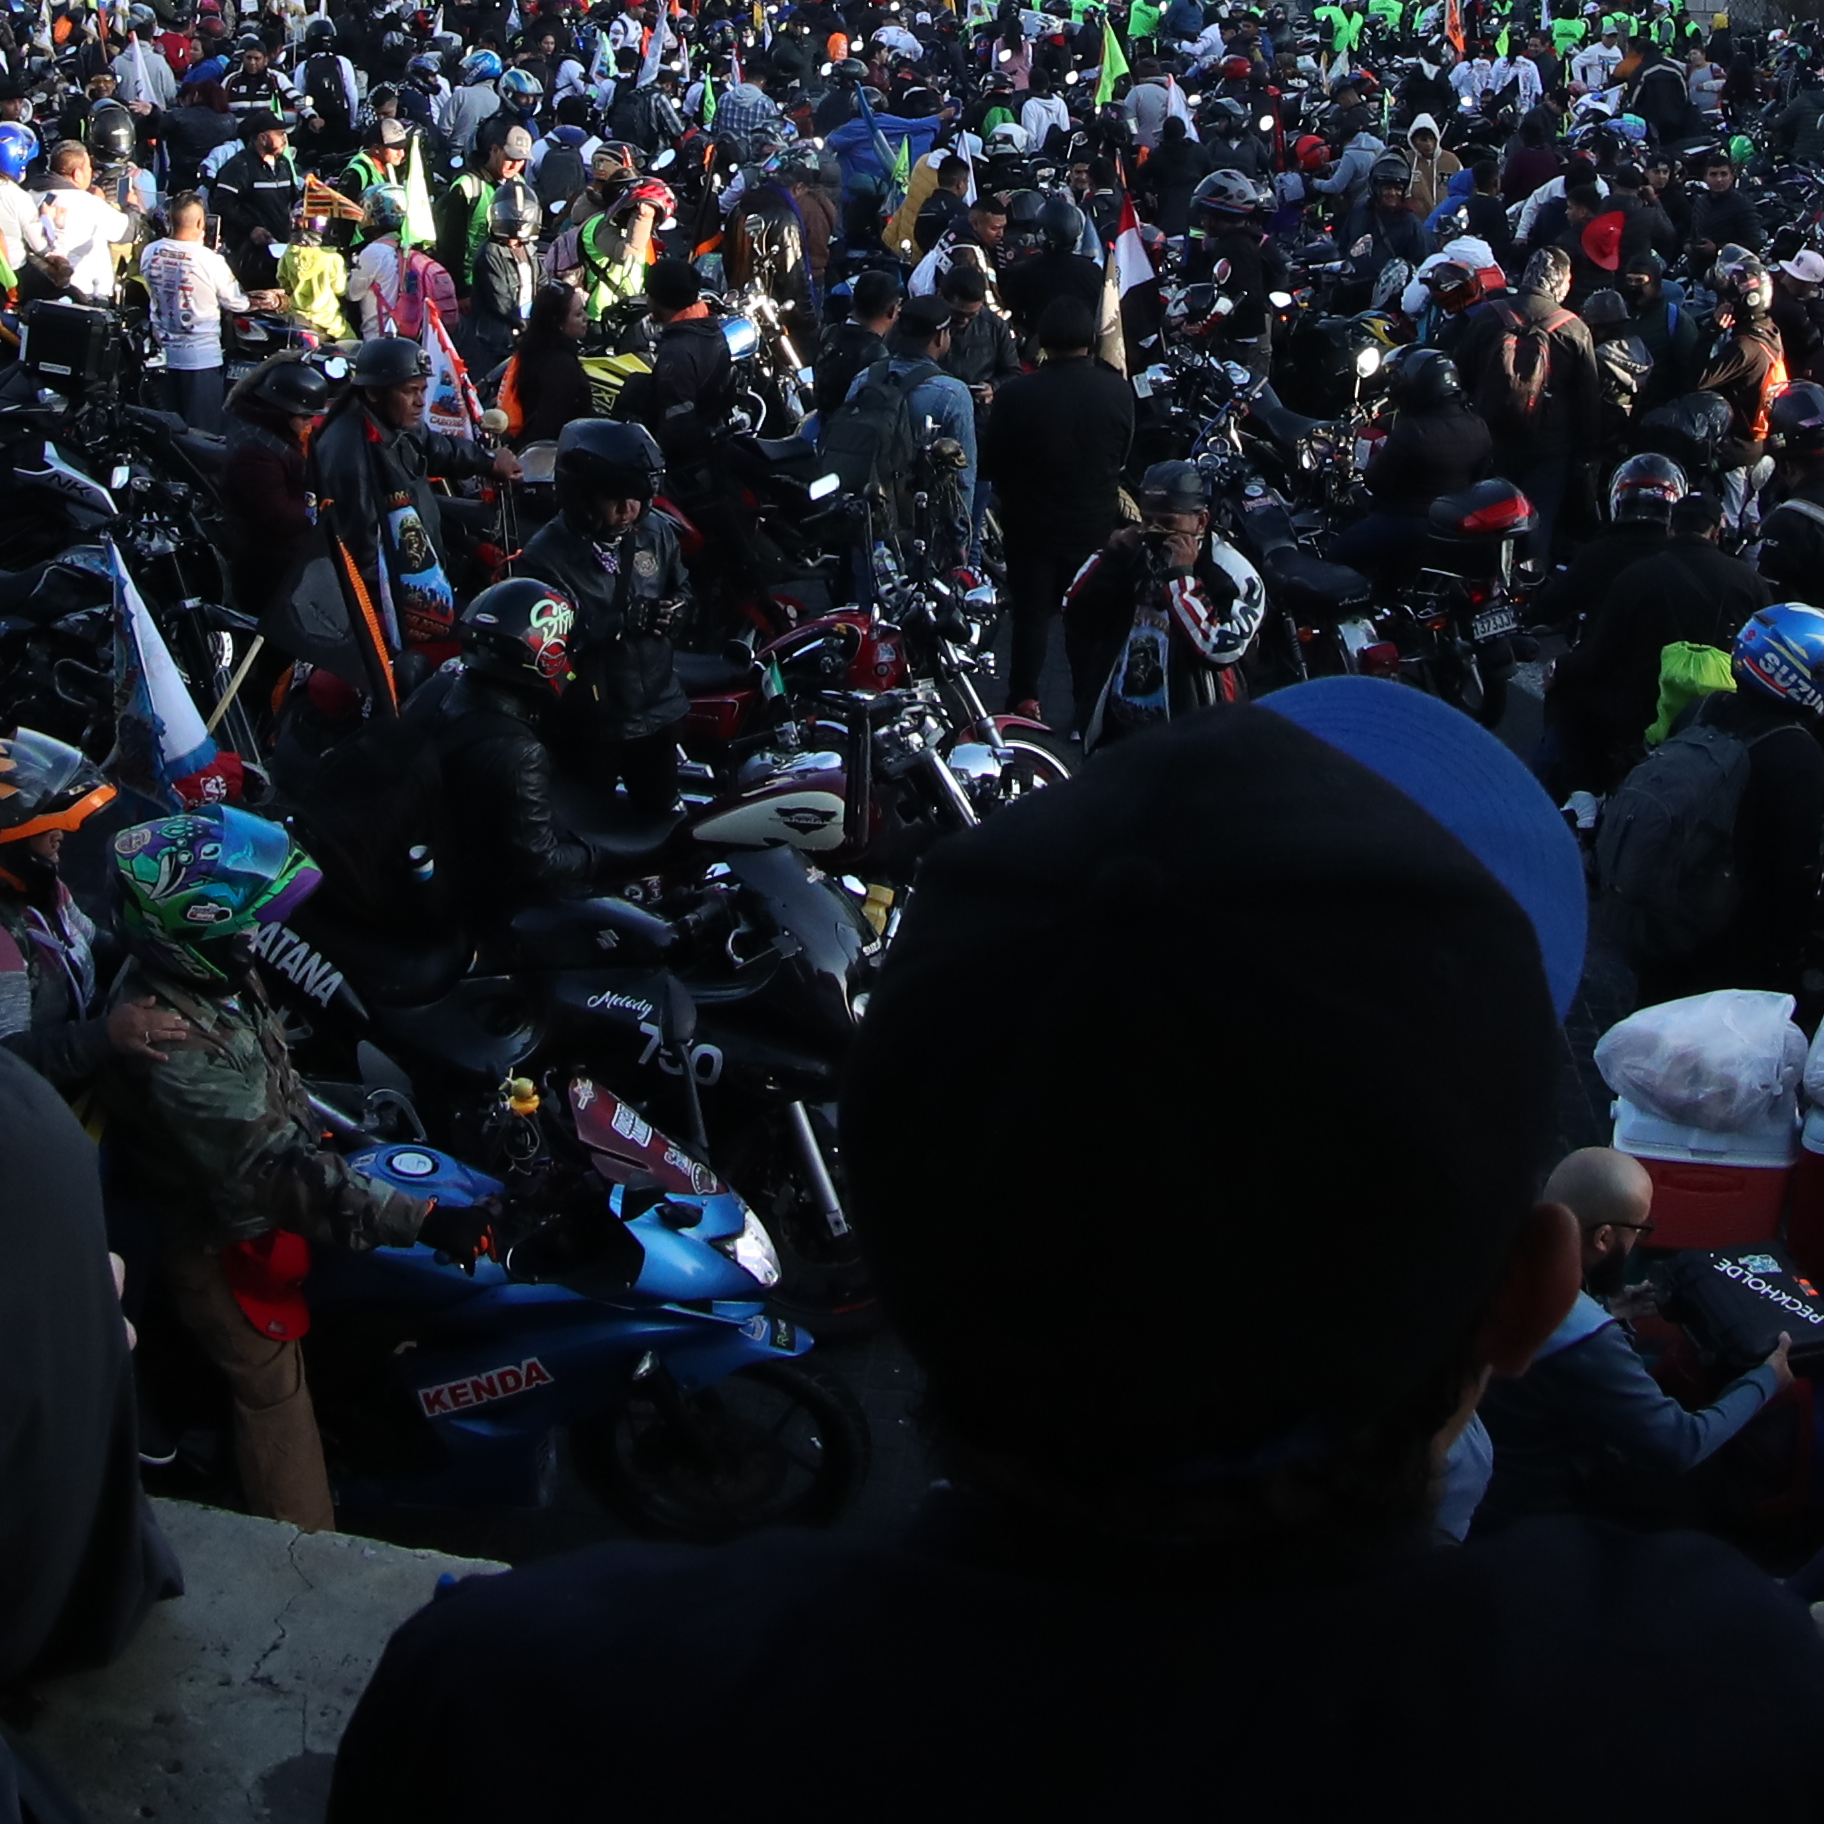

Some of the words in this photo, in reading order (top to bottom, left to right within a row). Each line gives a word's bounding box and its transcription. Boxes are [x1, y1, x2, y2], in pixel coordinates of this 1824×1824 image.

[46, 472, 88, 498] NK
[1212, 575, 1264, 654] USA
[587, 979, 654, 1021] Melody
[421, 1359, 552, 1415] KENDA
